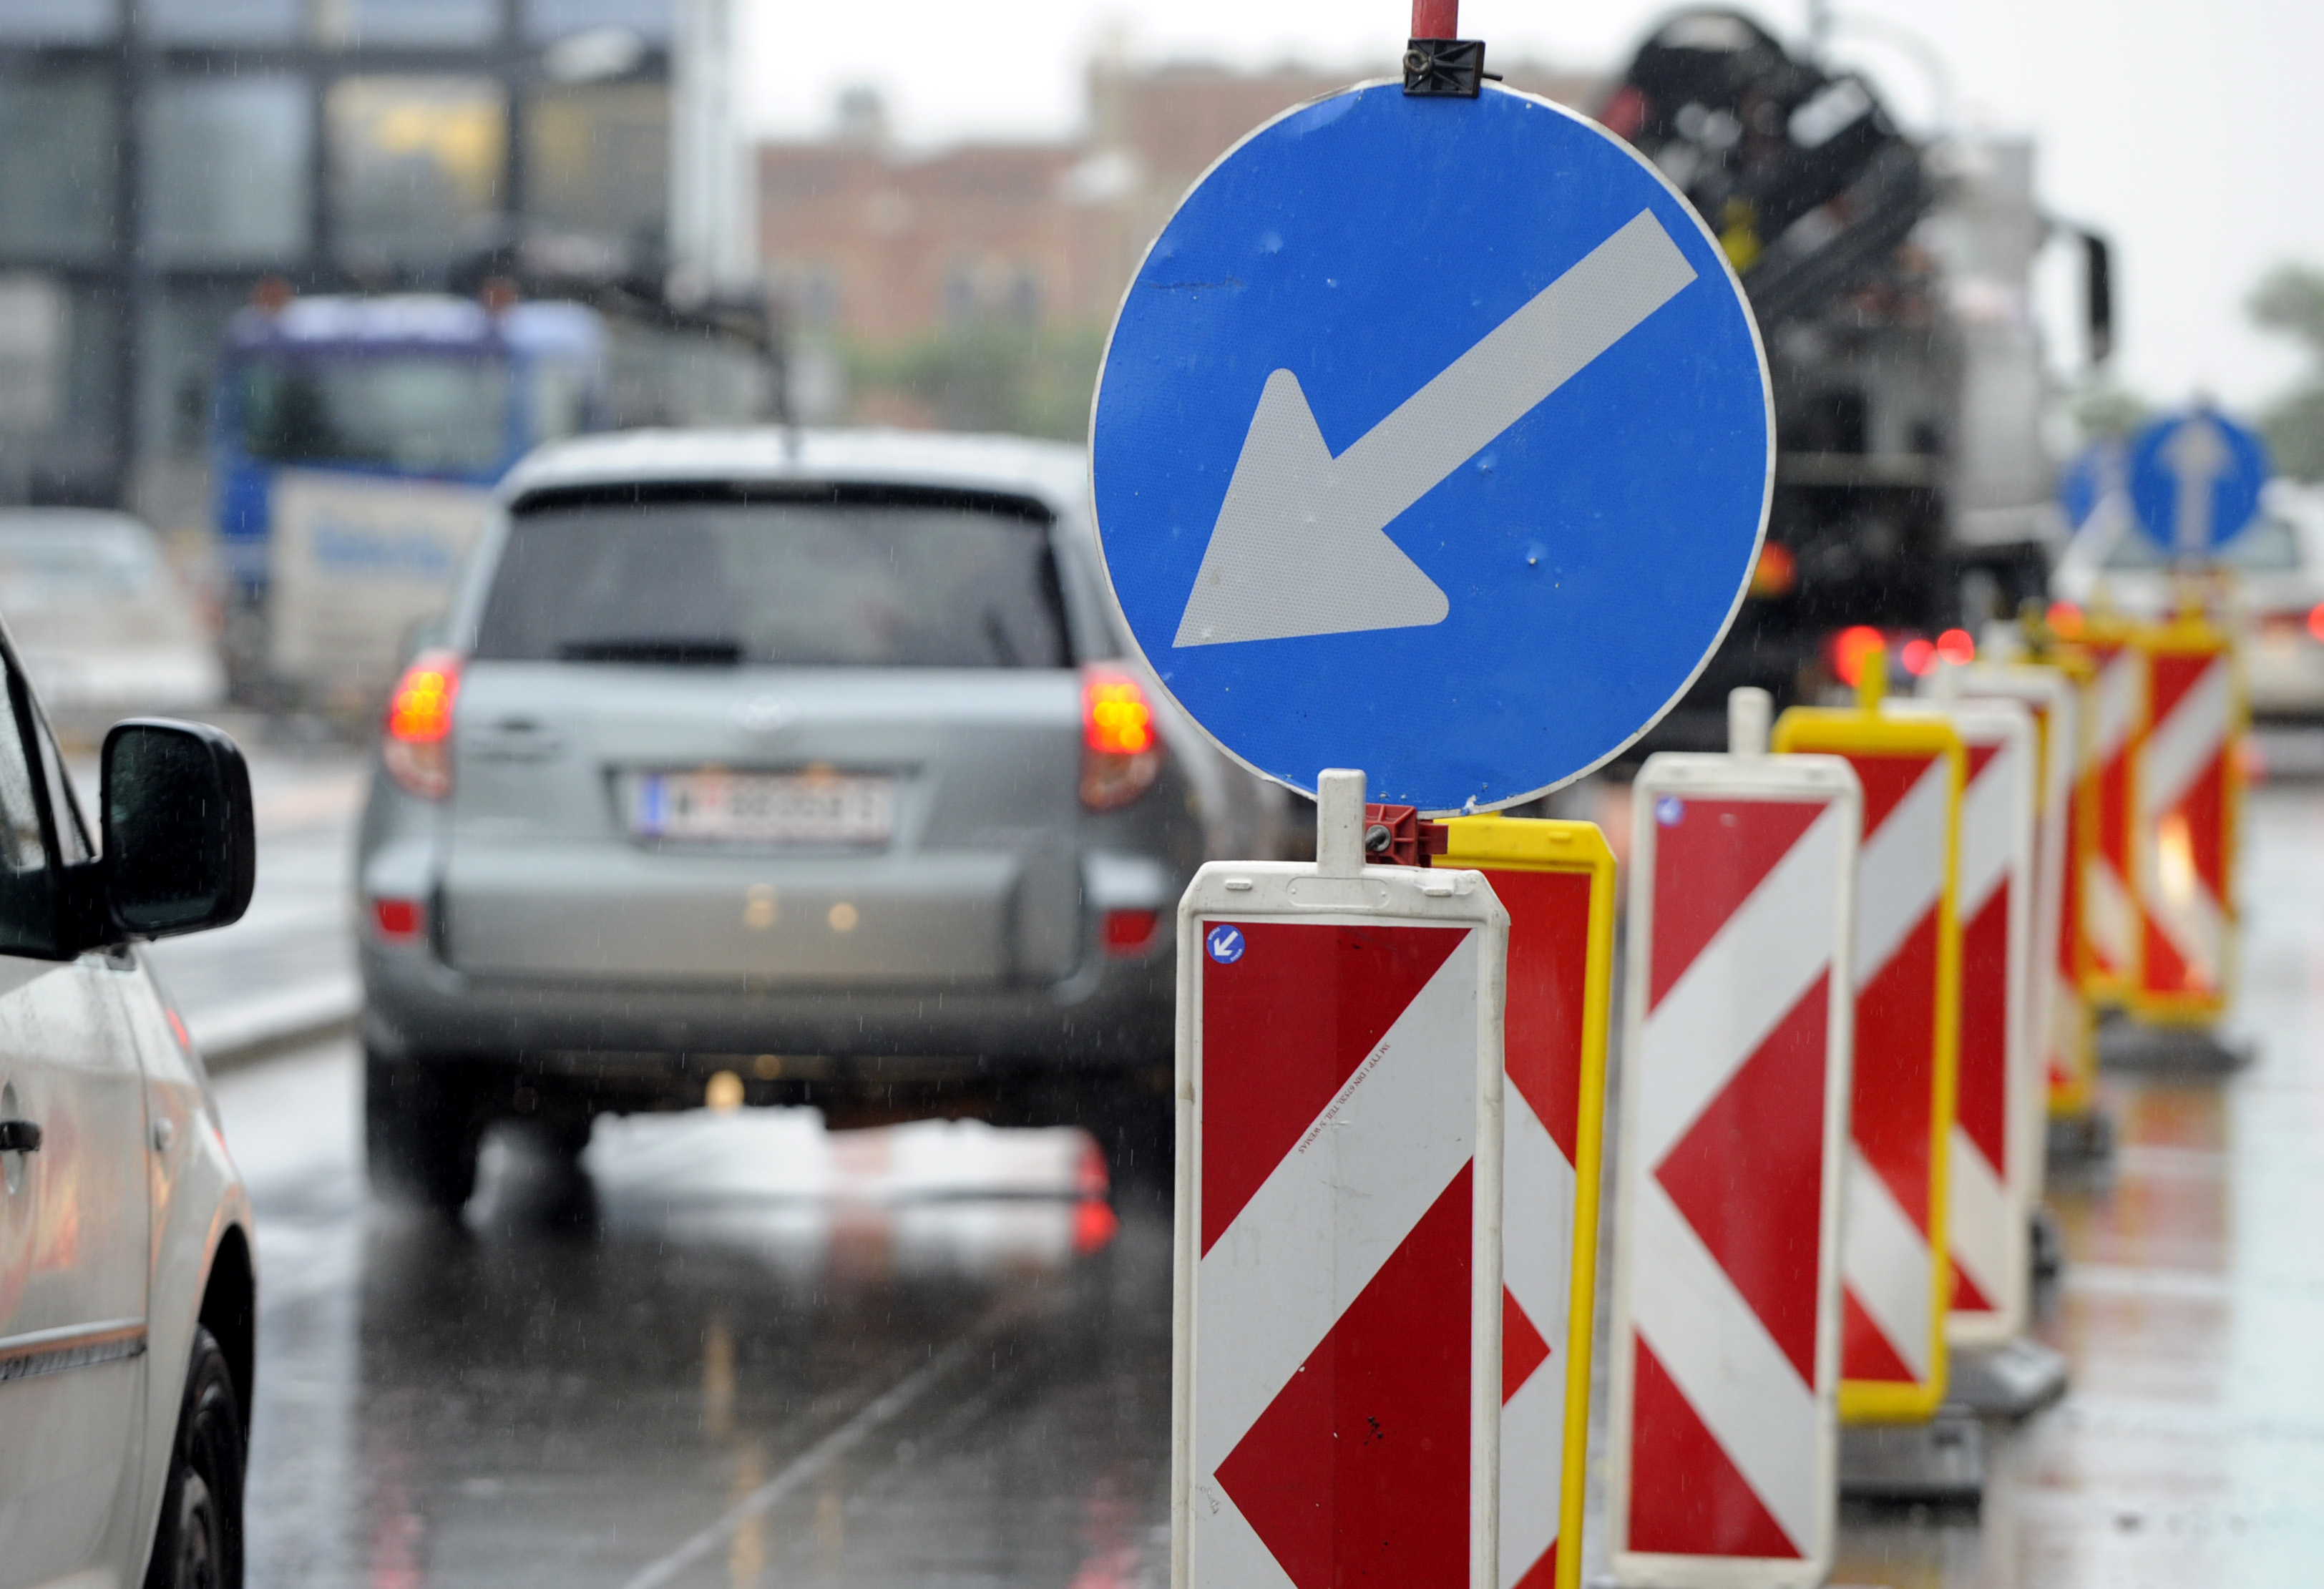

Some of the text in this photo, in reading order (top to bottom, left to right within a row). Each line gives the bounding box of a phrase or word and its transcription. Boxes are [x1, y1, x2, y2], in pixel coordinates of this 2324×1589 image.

[1369, 1054, 1382, 1068] TYP
[1354, 1072, 1367, 1087] DIN
[1324, 1105, 1340, 1120] TEIL
[1298, 1127, 1321, 1154] WEMAS
